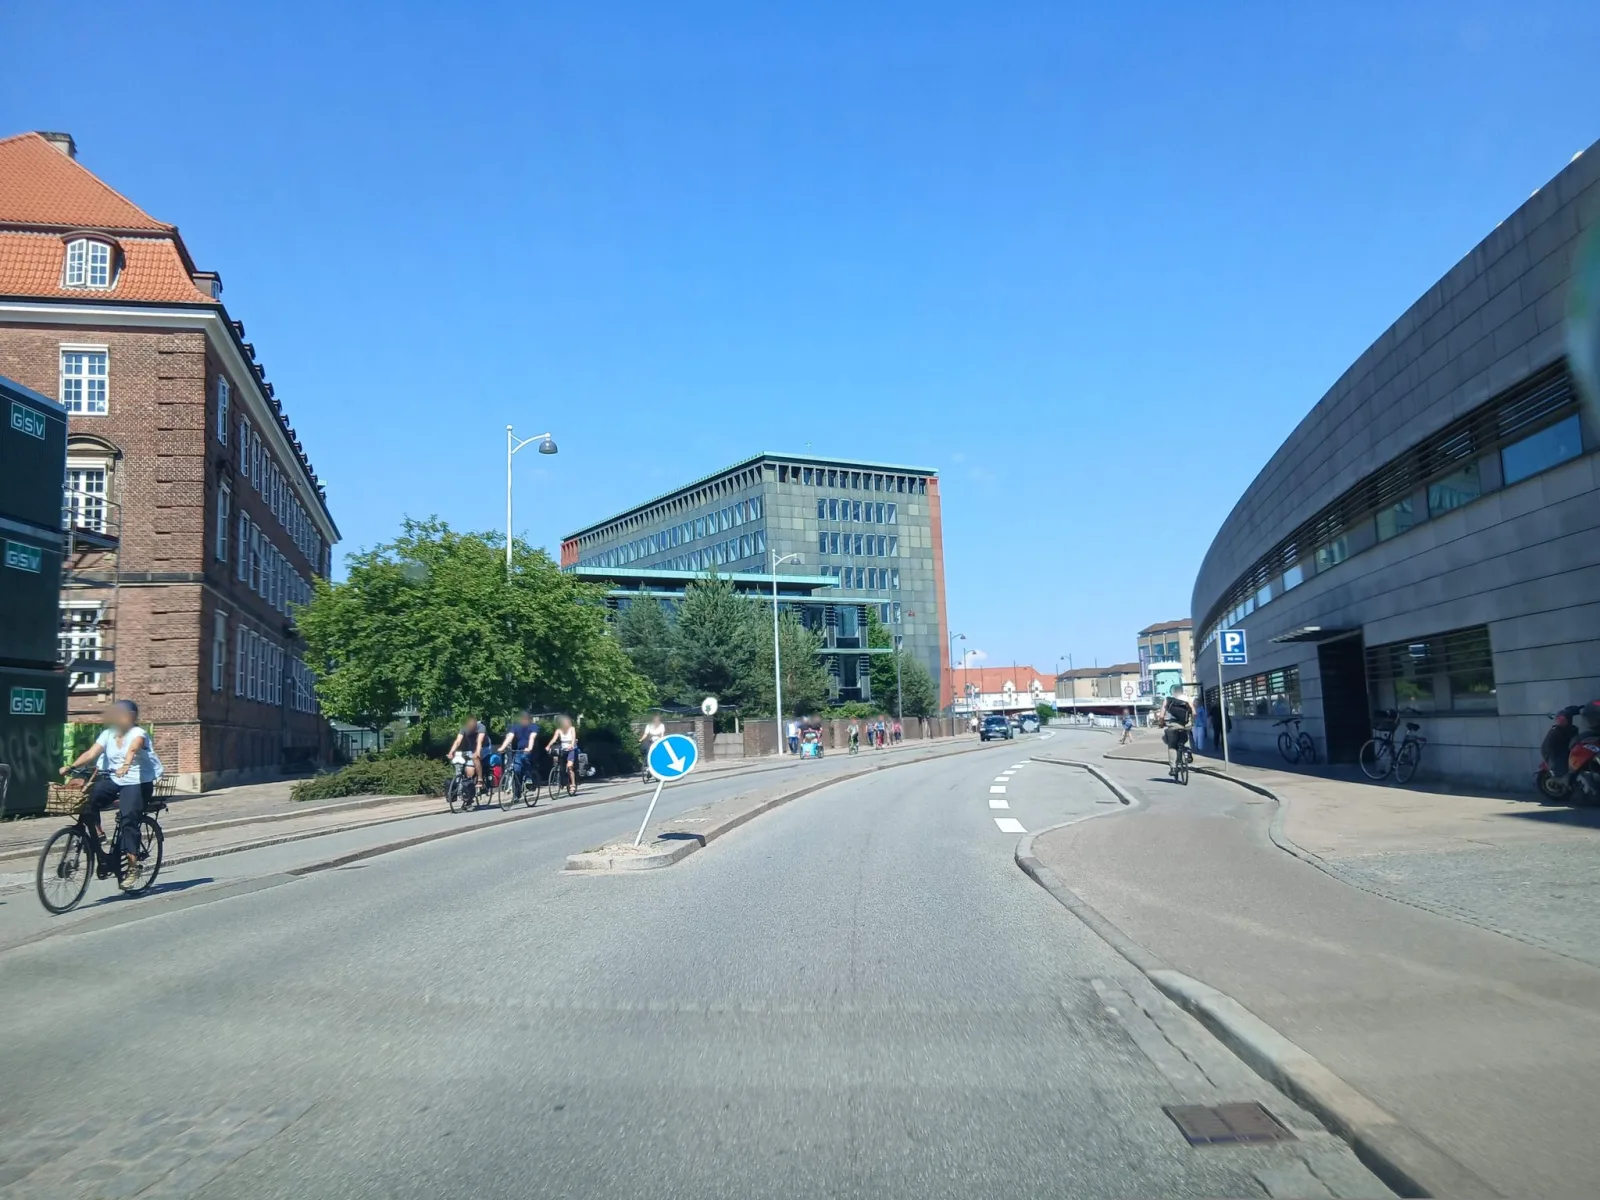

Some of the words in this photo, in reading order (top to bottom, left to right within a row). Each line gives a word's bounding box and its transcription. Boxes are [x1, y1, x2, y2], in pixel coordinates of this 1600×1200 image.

[13, 412, 44, 436] GSV
[7, 550, 40, 570] GSV
[1225, 632, 1241, 653] P
[12, 697, 44, 712] GSV
